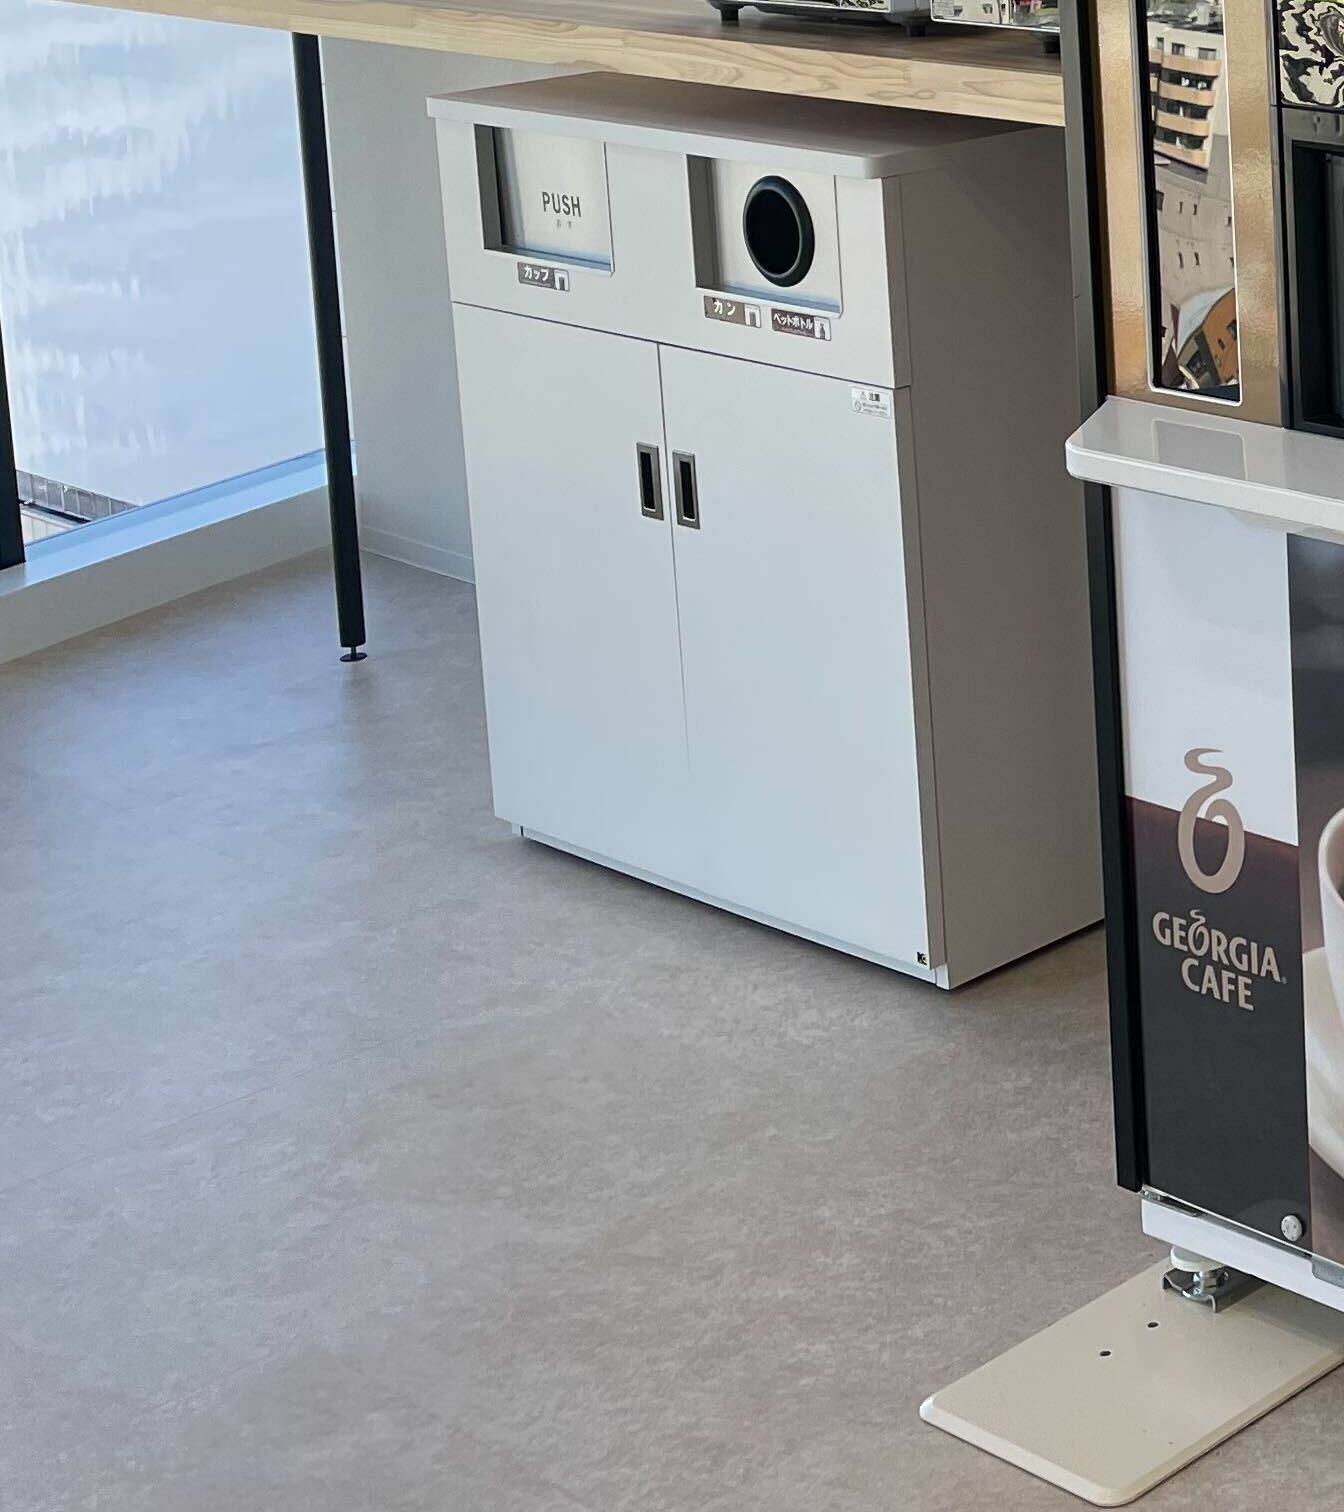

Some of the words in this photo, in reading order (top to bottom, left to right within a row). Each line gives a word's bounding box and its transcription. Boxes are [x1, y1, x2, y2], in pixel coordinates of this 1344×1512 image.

[542, 192, 582, 217] PUSH
[523, 266, 549, 282] カップ
[712, 300, 737, 316] カン
[774, 313, 814, 330] ペットボトル
[1153, 909, 1281, 984] GEORGIA
[1181, 959, 1254, 1011] CAFE
